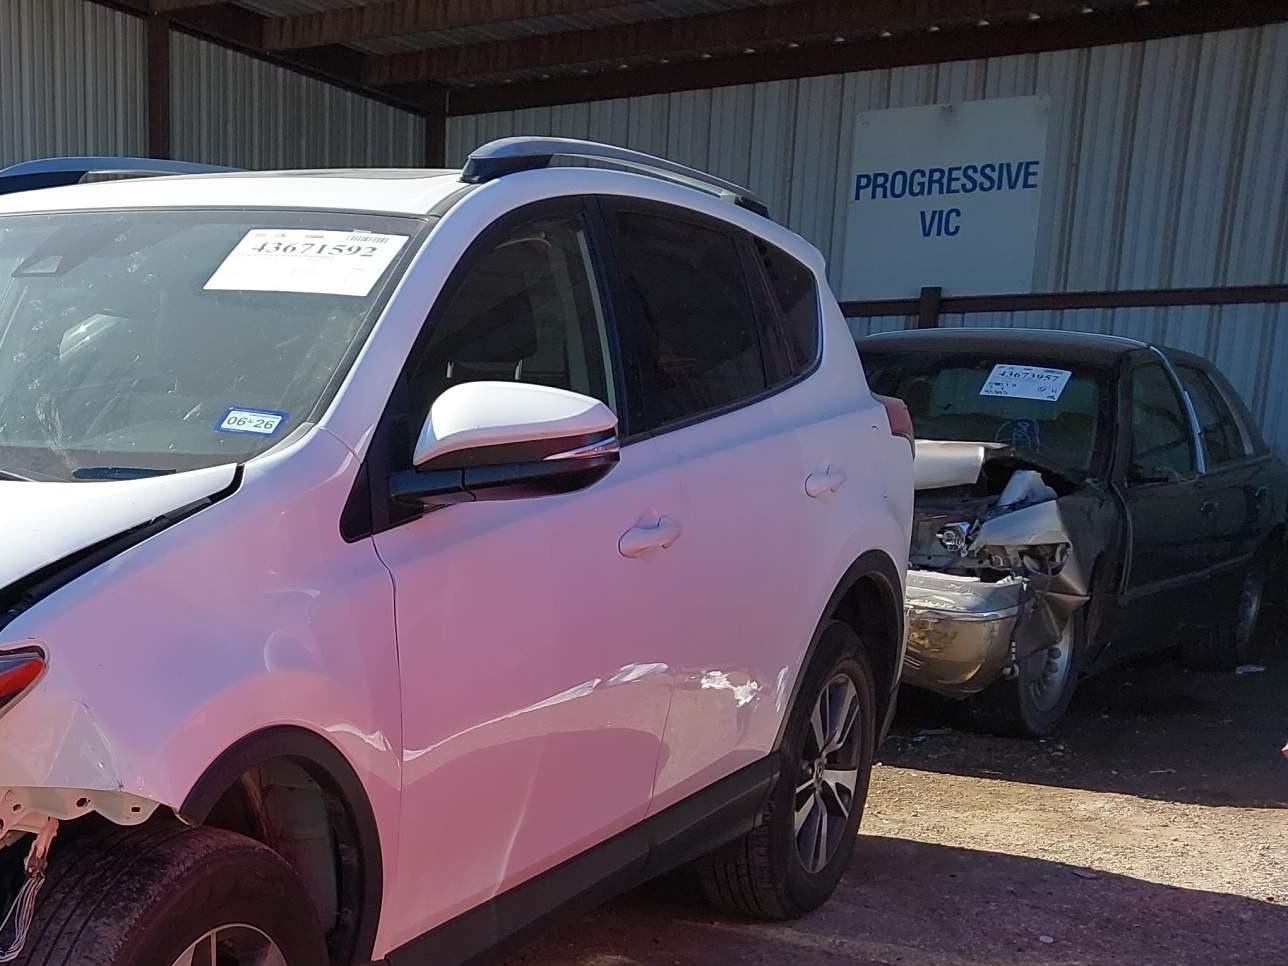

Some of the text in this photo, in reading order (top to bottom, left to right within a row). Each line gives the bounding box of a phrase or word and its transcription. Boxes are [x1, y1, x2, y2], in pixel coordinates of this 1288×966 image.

[854, 160, 1041, 201] PROGRESSIVE
[920, 208, 962, 238] VIC
[251, 241, 378, 257] 43671592
